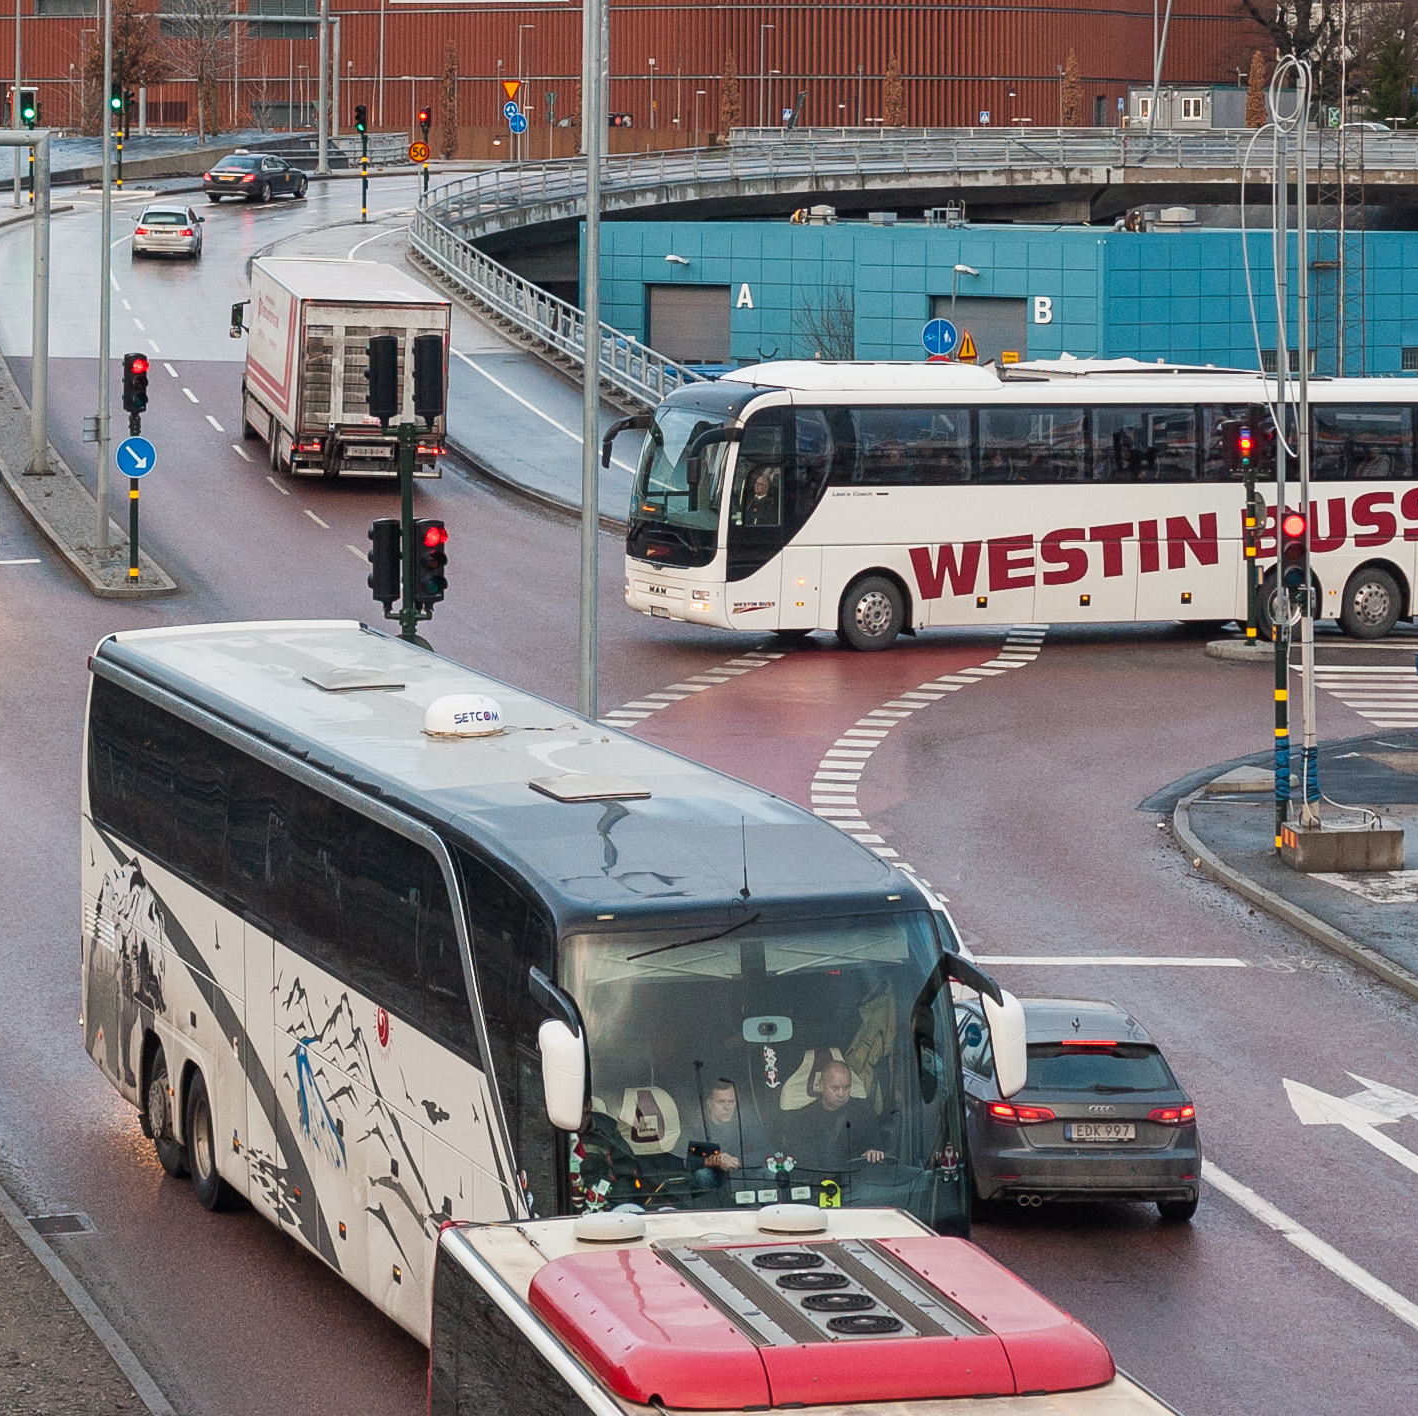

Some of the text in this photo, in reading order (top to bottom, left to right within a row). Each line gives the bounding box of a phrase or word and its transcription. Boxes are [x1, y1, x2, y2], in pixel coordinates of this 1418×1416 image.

[413, 146, 427, 158] 50
[736, 283, 755, 309] A
[1033, 296, 1053, 324] B
[908, 513, 1219, 601] WESTIN
[649, 585, 667, 595] MAN
[454, 711, 499, 724] SETCOM
[1076, 1125, 1129, 1136] EDK 997
